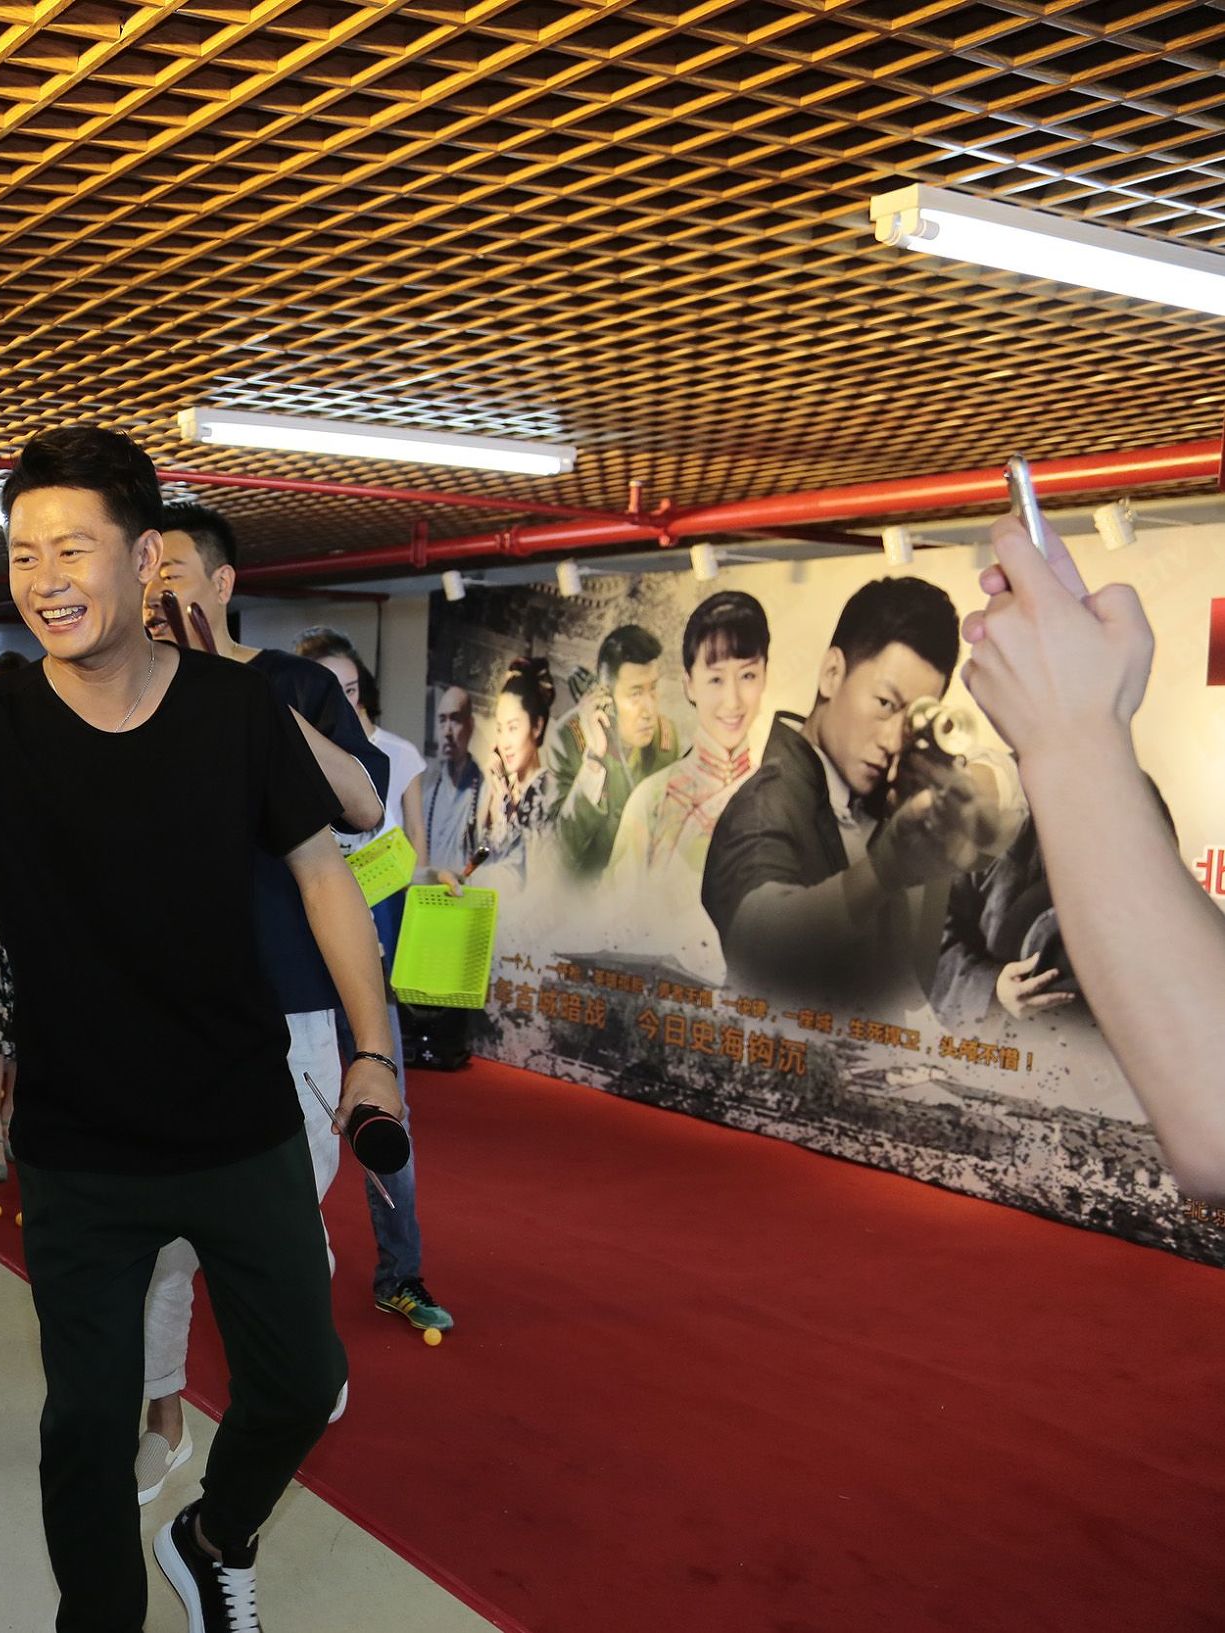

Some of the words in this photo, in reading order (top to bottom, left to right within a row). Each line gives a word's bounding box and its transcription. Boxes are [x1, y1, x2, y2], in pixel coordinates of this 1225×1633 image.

[637, 1007, 808, 1077] 今日史海钩沉
